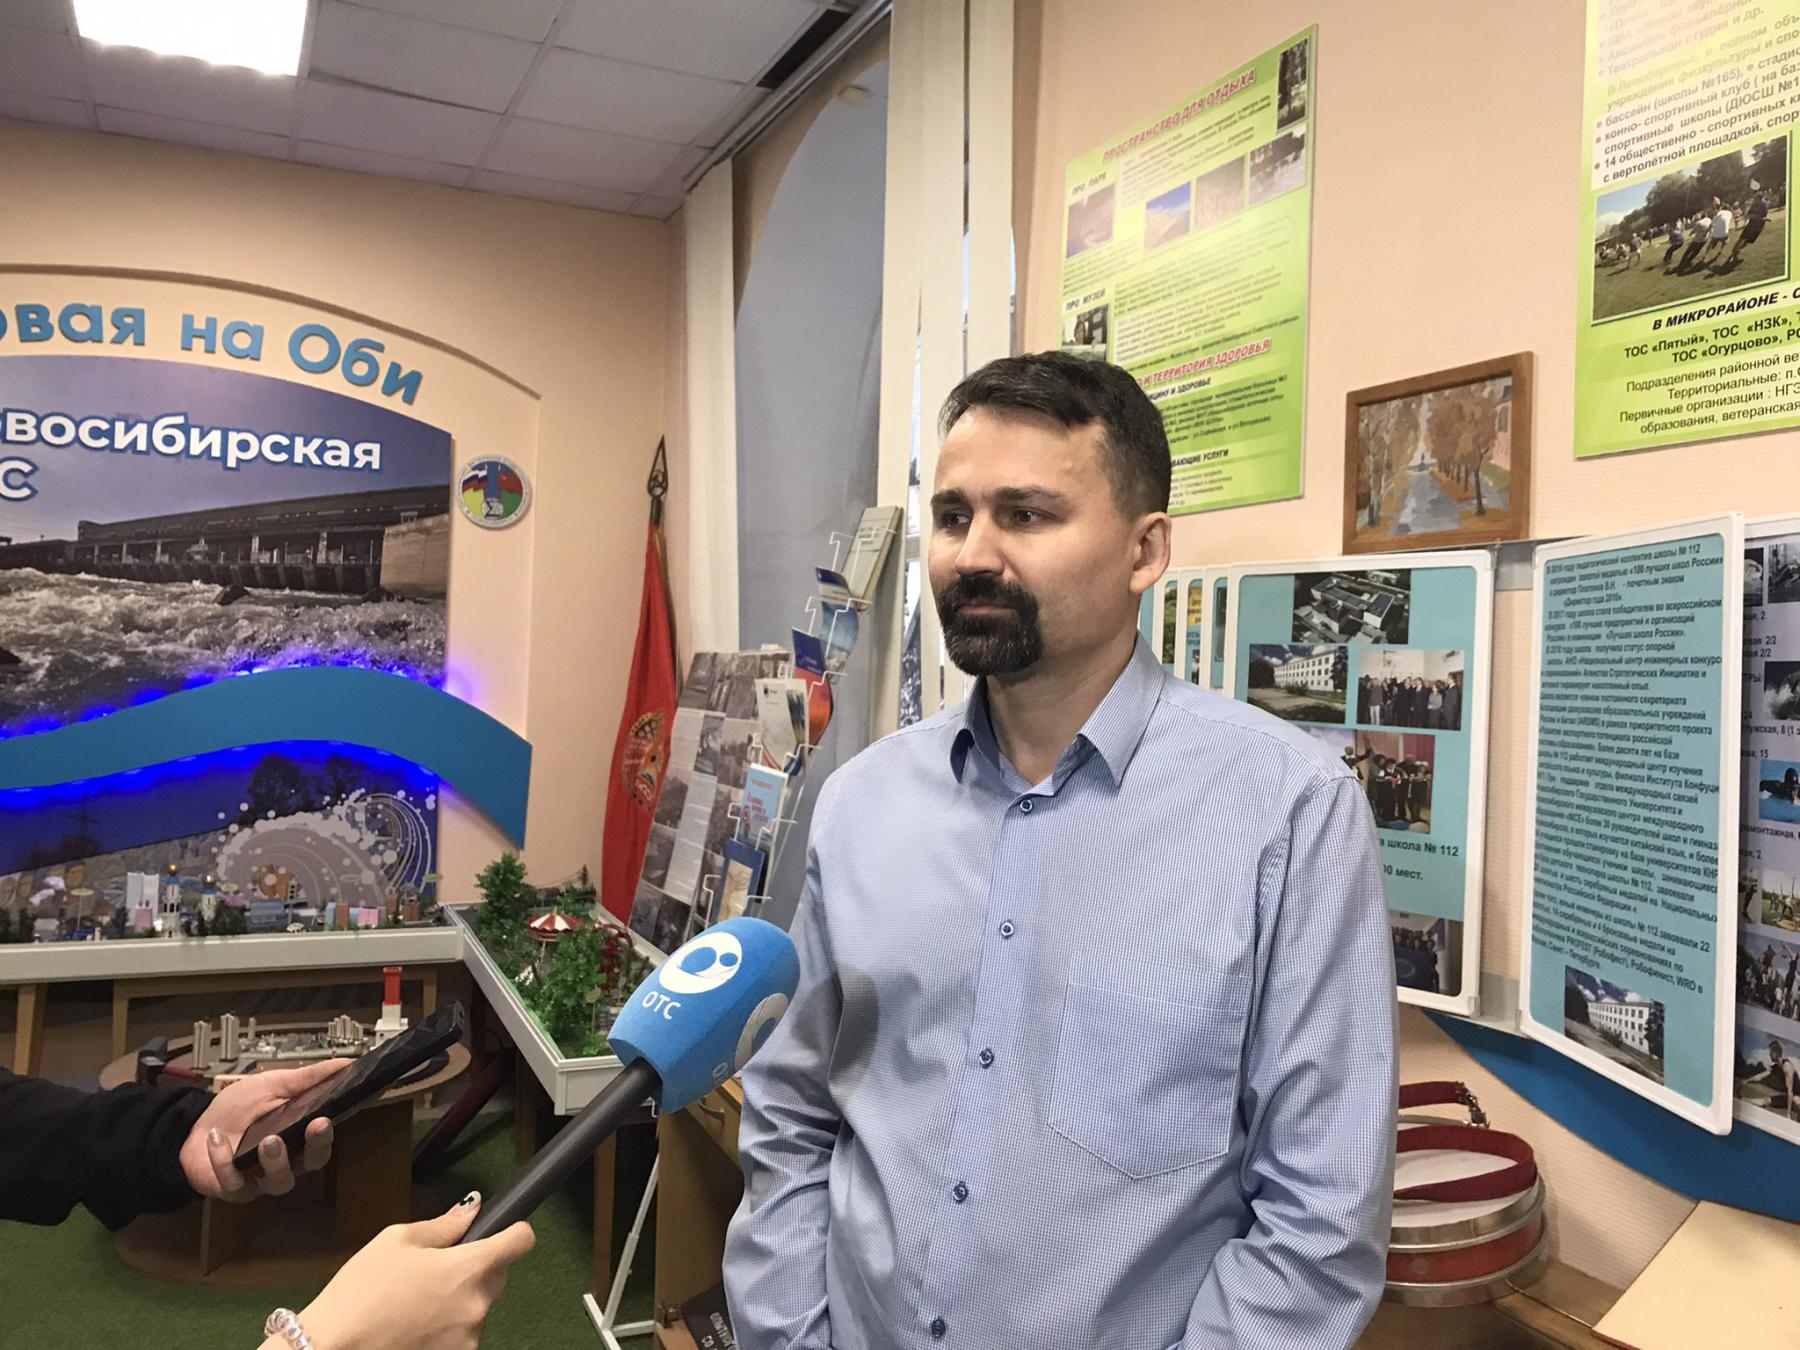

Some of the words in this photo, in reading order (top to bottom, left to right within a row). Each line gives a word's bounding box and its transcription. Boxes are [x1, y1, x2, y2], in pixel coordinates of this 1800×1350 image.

[1643, 92, 1719, 128] спортивный
[1720, 79, 1751, 99] клуб
[1761, 70, 1778, 84] на
[1102, 112, 1180, 163] ПРОСТРАНСТВО
[1180, 100, 1205, 121] ДЛЯ
[1205, 69, 1255, 108] ОТДЫХА
[1604, 122, 1675, 155] спортивные
[1680, 107, 1722, 128] школы
[1725, 86, 1774, 114] (ДЮСШ
[1605, 104, 1652, 128] бассейн
[1604, 158, 1617, 169] 14
[1618, 130, 1697, 164] общественно
[1707, 99, 1786, 133] спортивных
[1603, 173, 1610, 183] с
[1689, 122, 1763, 155] площадкой,
[1652, 319, 1662, 331] В
[1665, 292, 1780, 328] МИКРОРАЙОНЕ
[0, 302, 146, 346] вая
[180, 312, 265, 362] на
[287, 323, 424, 406] Оби
[1624, 344, 1649, 358] ТОС
[1651, 333, 1709, 352] «Пятый»,
[1712, 325, 1739, 340] ТОС
[1672, 349, 1698, 363] ТОС
[1700, 335, 1783, 356] «Огурцово»,
[1152, 356, 1214, 384] ТЕРРИТОРИЯ
[1214, 338, 1272, 367] ЗДОРОВЬЯ
[1626, 367, 1716, 393] Подразделения
[1719, 354, 1780, 378] районной
[1177, 376, 1211, 393] ЗДОРОВЬЕ
[1667, 373, 1782, 400] Территориальные:
[1619, 404, 1684, 423] Первичные
[1686, 390, 1764, 413] организации
[0, 409, 384, 472] восибирская
[1640, 415, 1719, 435] образования,
[1203, 448, 1229, 461] УСЛУГИ
[1689, 543, 1700, 554] 112
[1760, 748, 1769, 759] 15
[1387, 840, 1422, 852] школа
[1424, 842, 1437, 854] №
[1439, 845, 1459, 857] 112
[1395, 868, 1424, 881] мест.
[1700, 940, 1711, 953] 22
